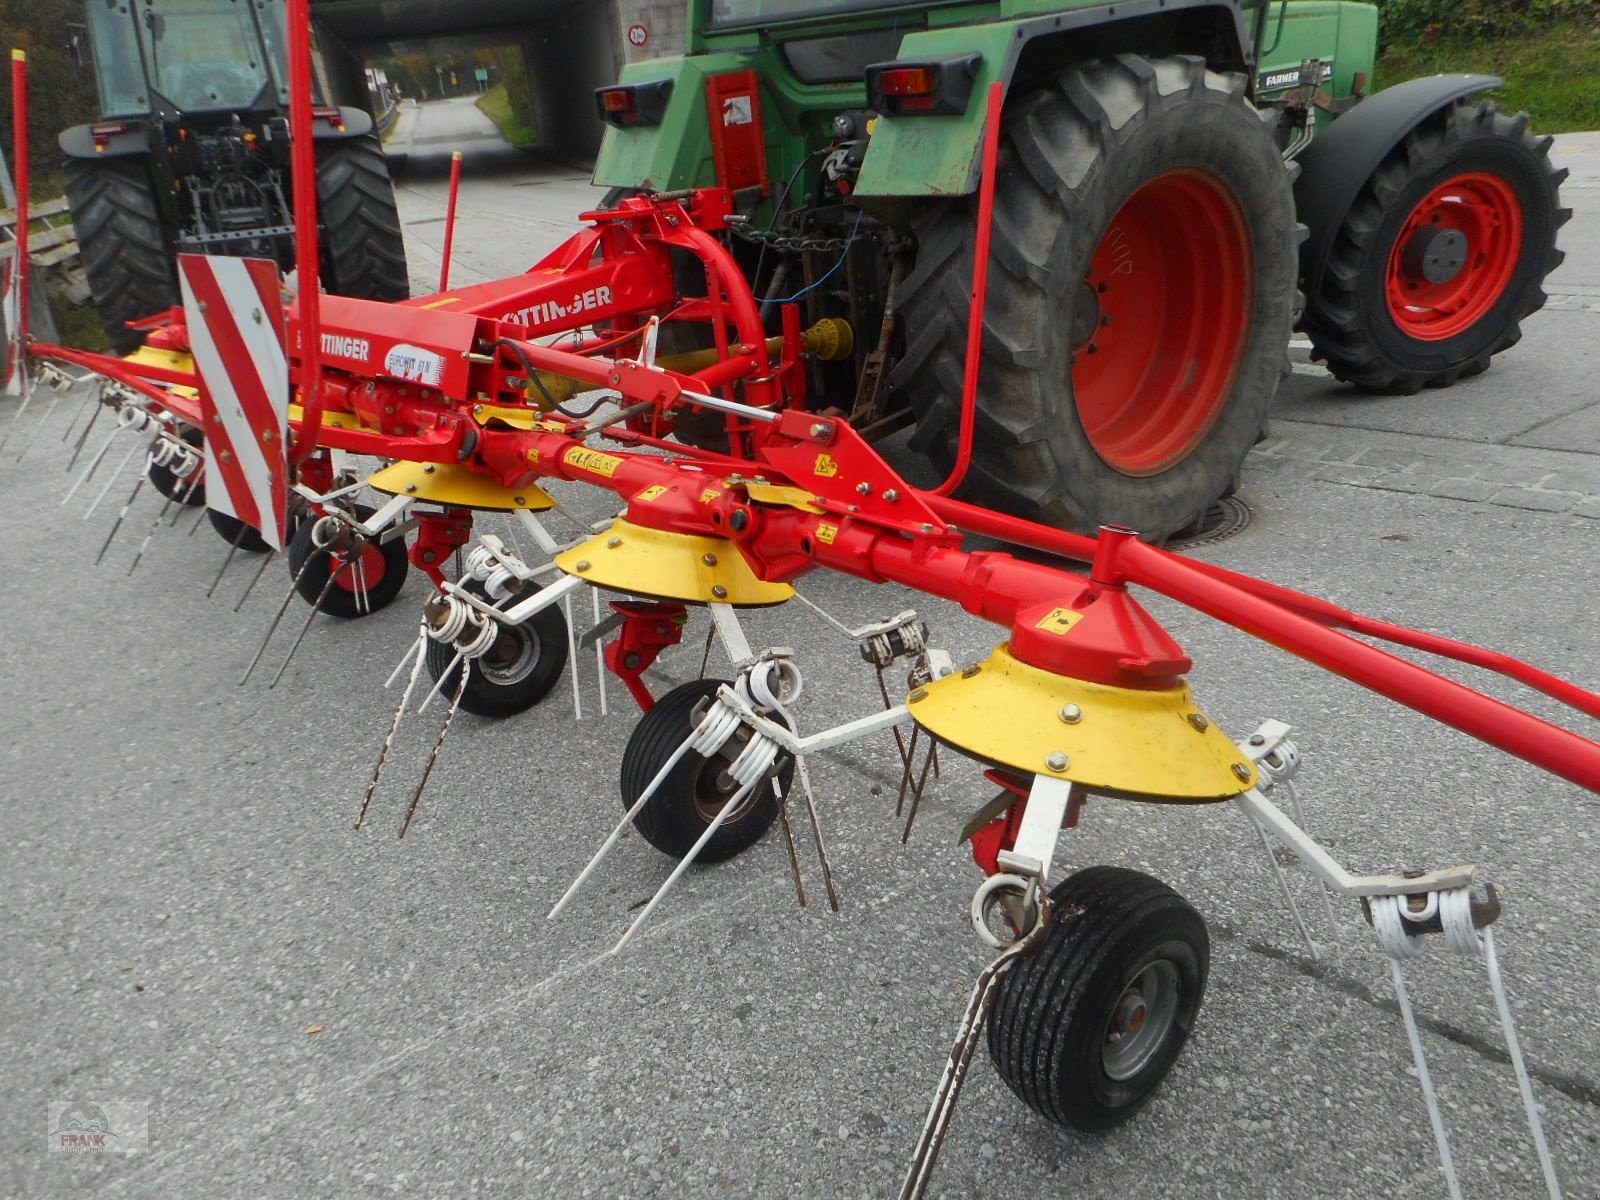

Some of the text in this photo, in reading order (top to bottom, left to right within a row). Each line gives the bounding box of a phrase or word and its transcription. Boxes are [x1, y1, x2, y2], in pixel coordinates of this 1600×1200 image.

[1265, 71, 1300, 87] FARMER
[501, 285, 613, 328] ÖTTINGER
[320, 333, 369, 361] TTINGER
